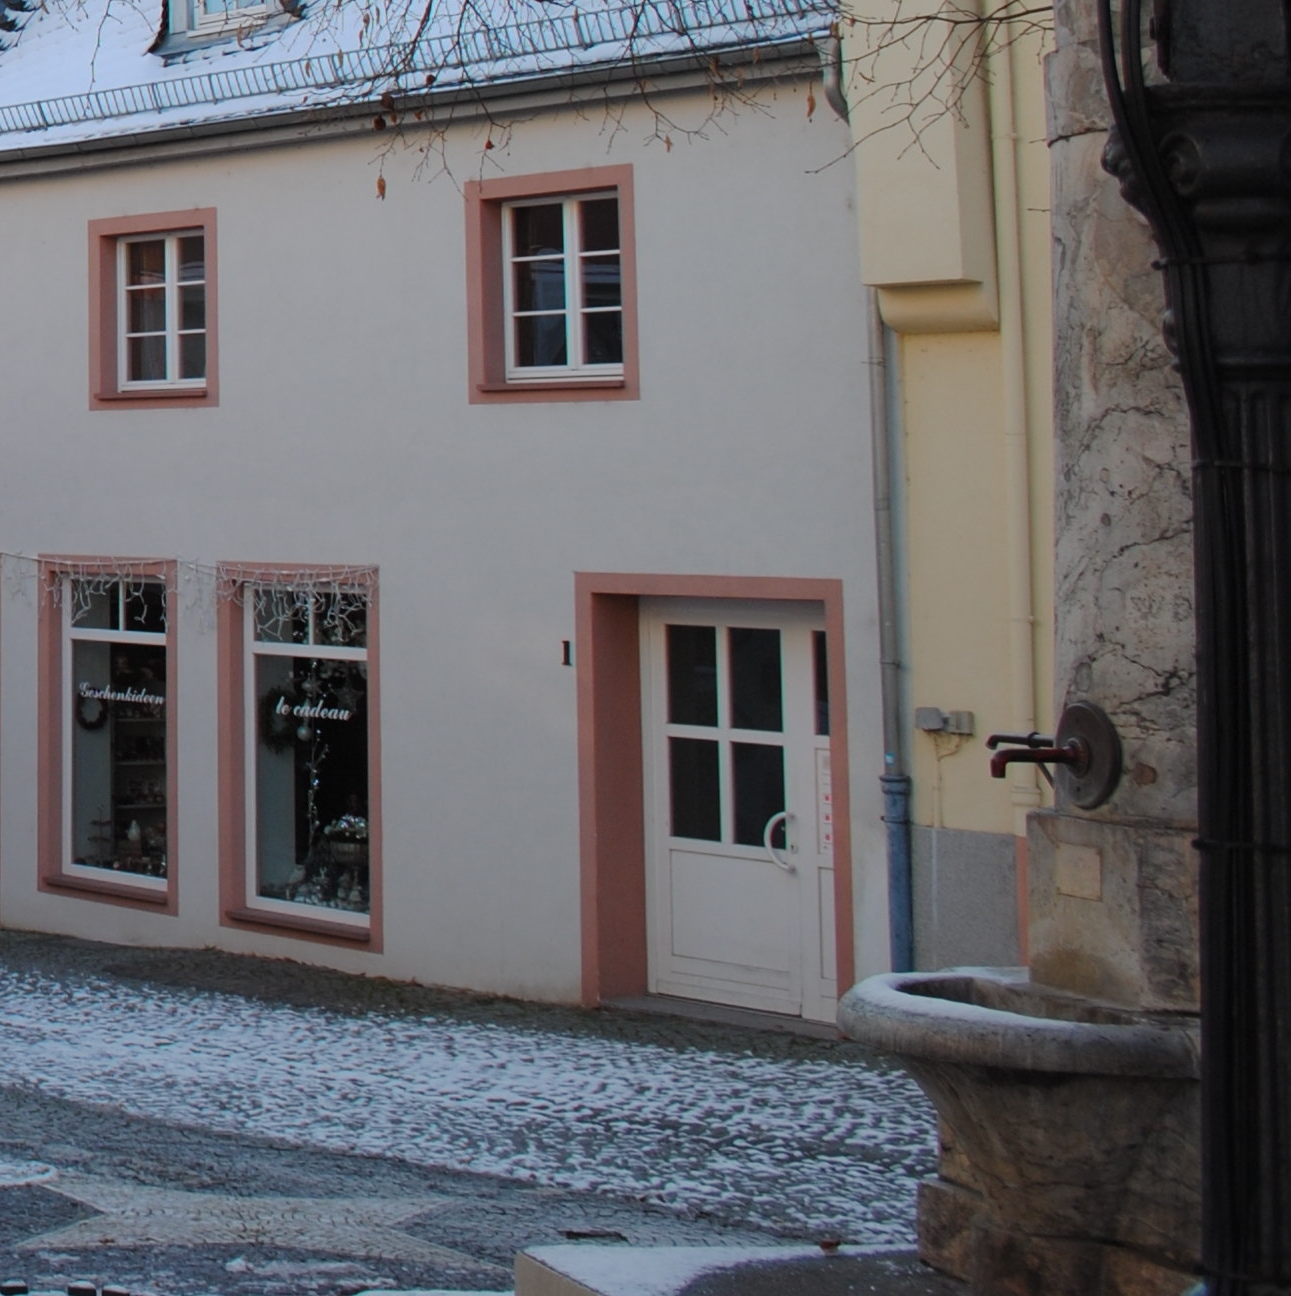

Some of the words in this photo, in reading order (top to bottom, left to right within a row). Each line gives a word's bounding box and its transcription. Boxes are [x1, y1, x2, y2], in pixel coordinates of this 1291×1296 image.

[79, 681, 165, 705] Geschenkideen
[275, 696, 291, 716] le
[293, 699, 353, 722] cadeau
